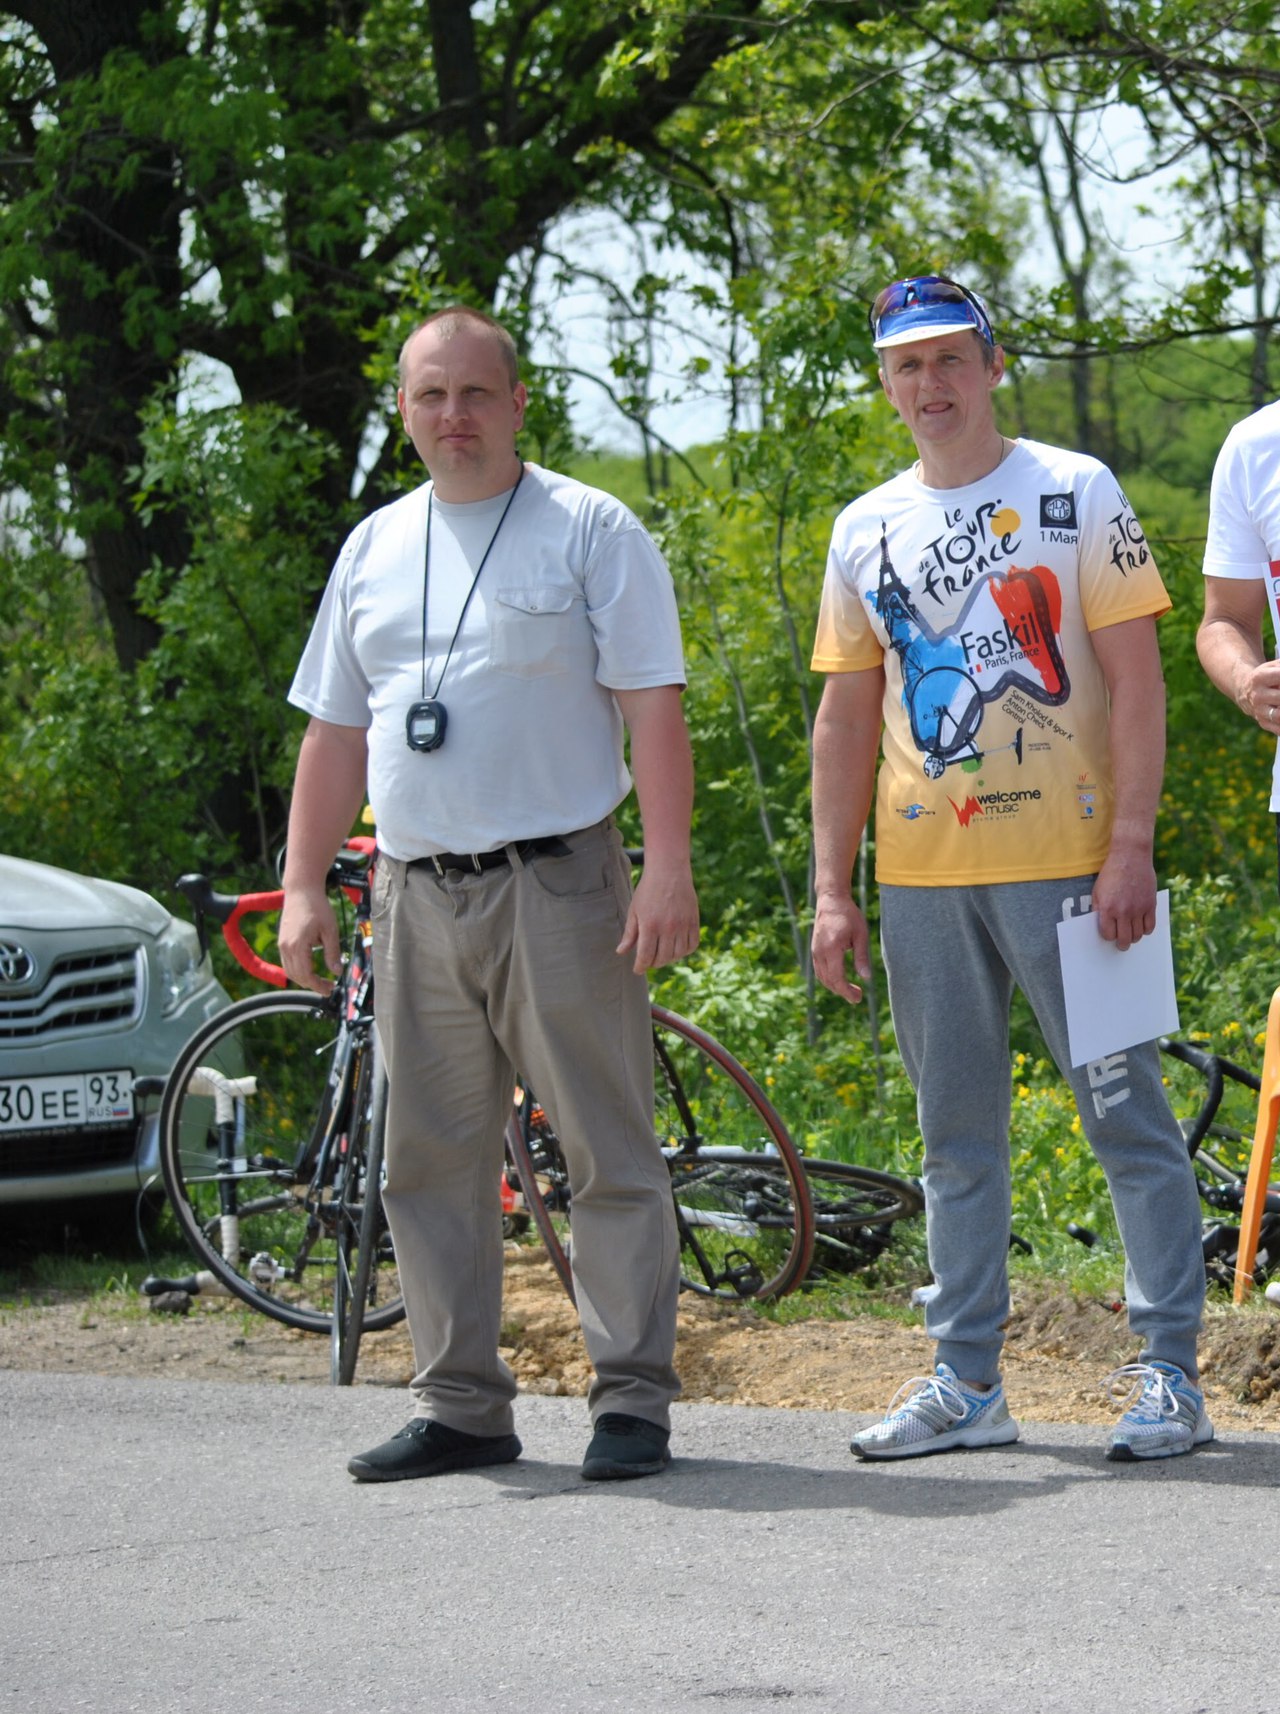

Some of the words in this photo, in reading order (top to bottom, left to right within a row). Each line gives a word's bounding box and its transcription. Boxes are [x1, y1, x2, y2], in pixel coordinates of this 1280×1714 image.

[1040, 531, 1045, 542] 1
[1050, 531, 1077, 545] Мая
[984, 658, 1010, 669] Paris,
[1009, 648, 1040, 662] France
[1002, 704, 1026, 725] Control
[1006, 697, 1028, 716] Anton
[1010, 690, 1025, 704] Sam
[1046, 718, 1054, 726] &
[977, 789, 1041, 804] welcome
[985, 803, 1019, 815] music
[88, 1105, 112, 1117] RUS
